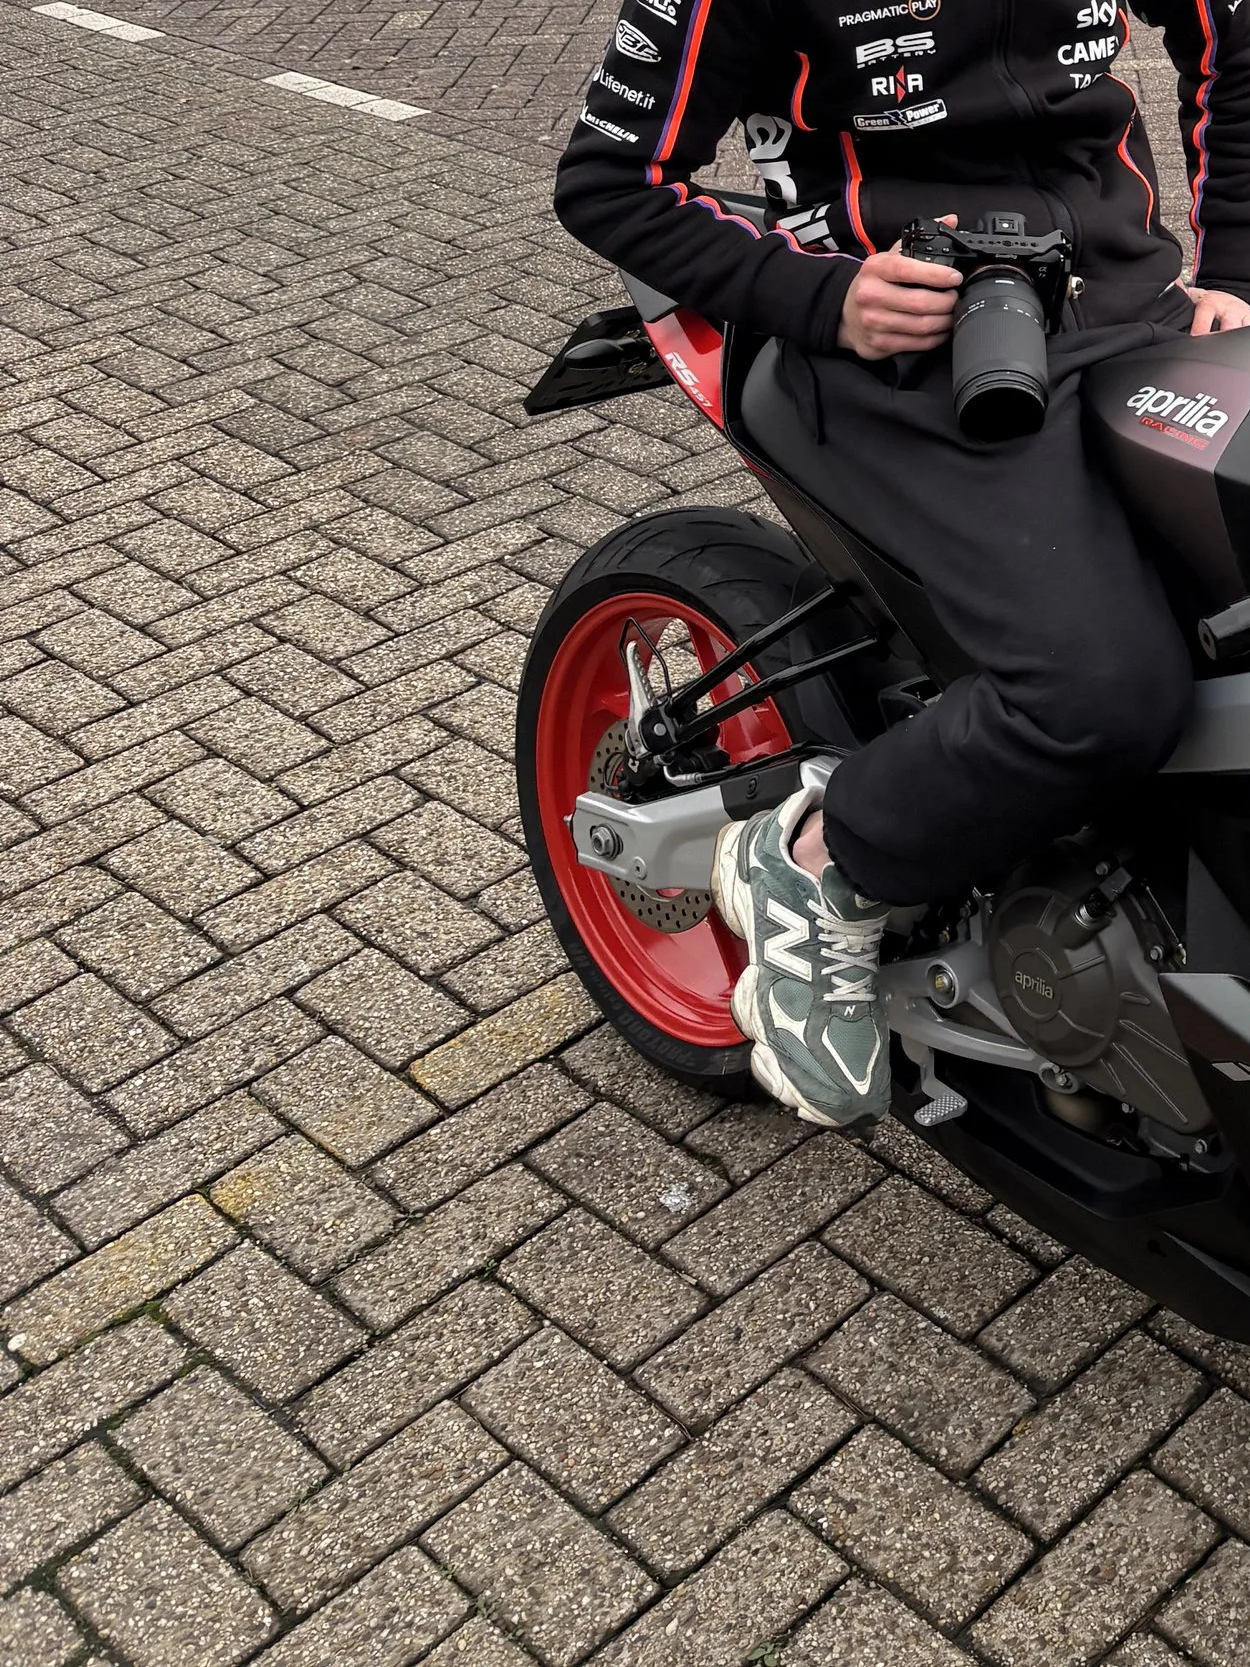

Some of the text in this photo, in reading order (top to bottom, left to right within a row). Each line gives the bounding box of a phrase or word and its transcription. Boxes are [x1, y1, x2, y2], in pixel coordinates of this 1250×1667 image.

[838, 3, 909, 28] PRAGMATIC
[855, 31, 936, 64] BS
[600, 68, 656, 110] Lifenet.it
[585, 113, 640, 144] MICHELIN
[857, 117, 890, 127] Green
[905, 103, 940, 122] Power
[664, 351, 701, 387] RS
[1126, 385, 1230, 439] aprilia
[1140, 416, 1211, 452] RACING
[1014, 970, 1054, 1000] aprilia
